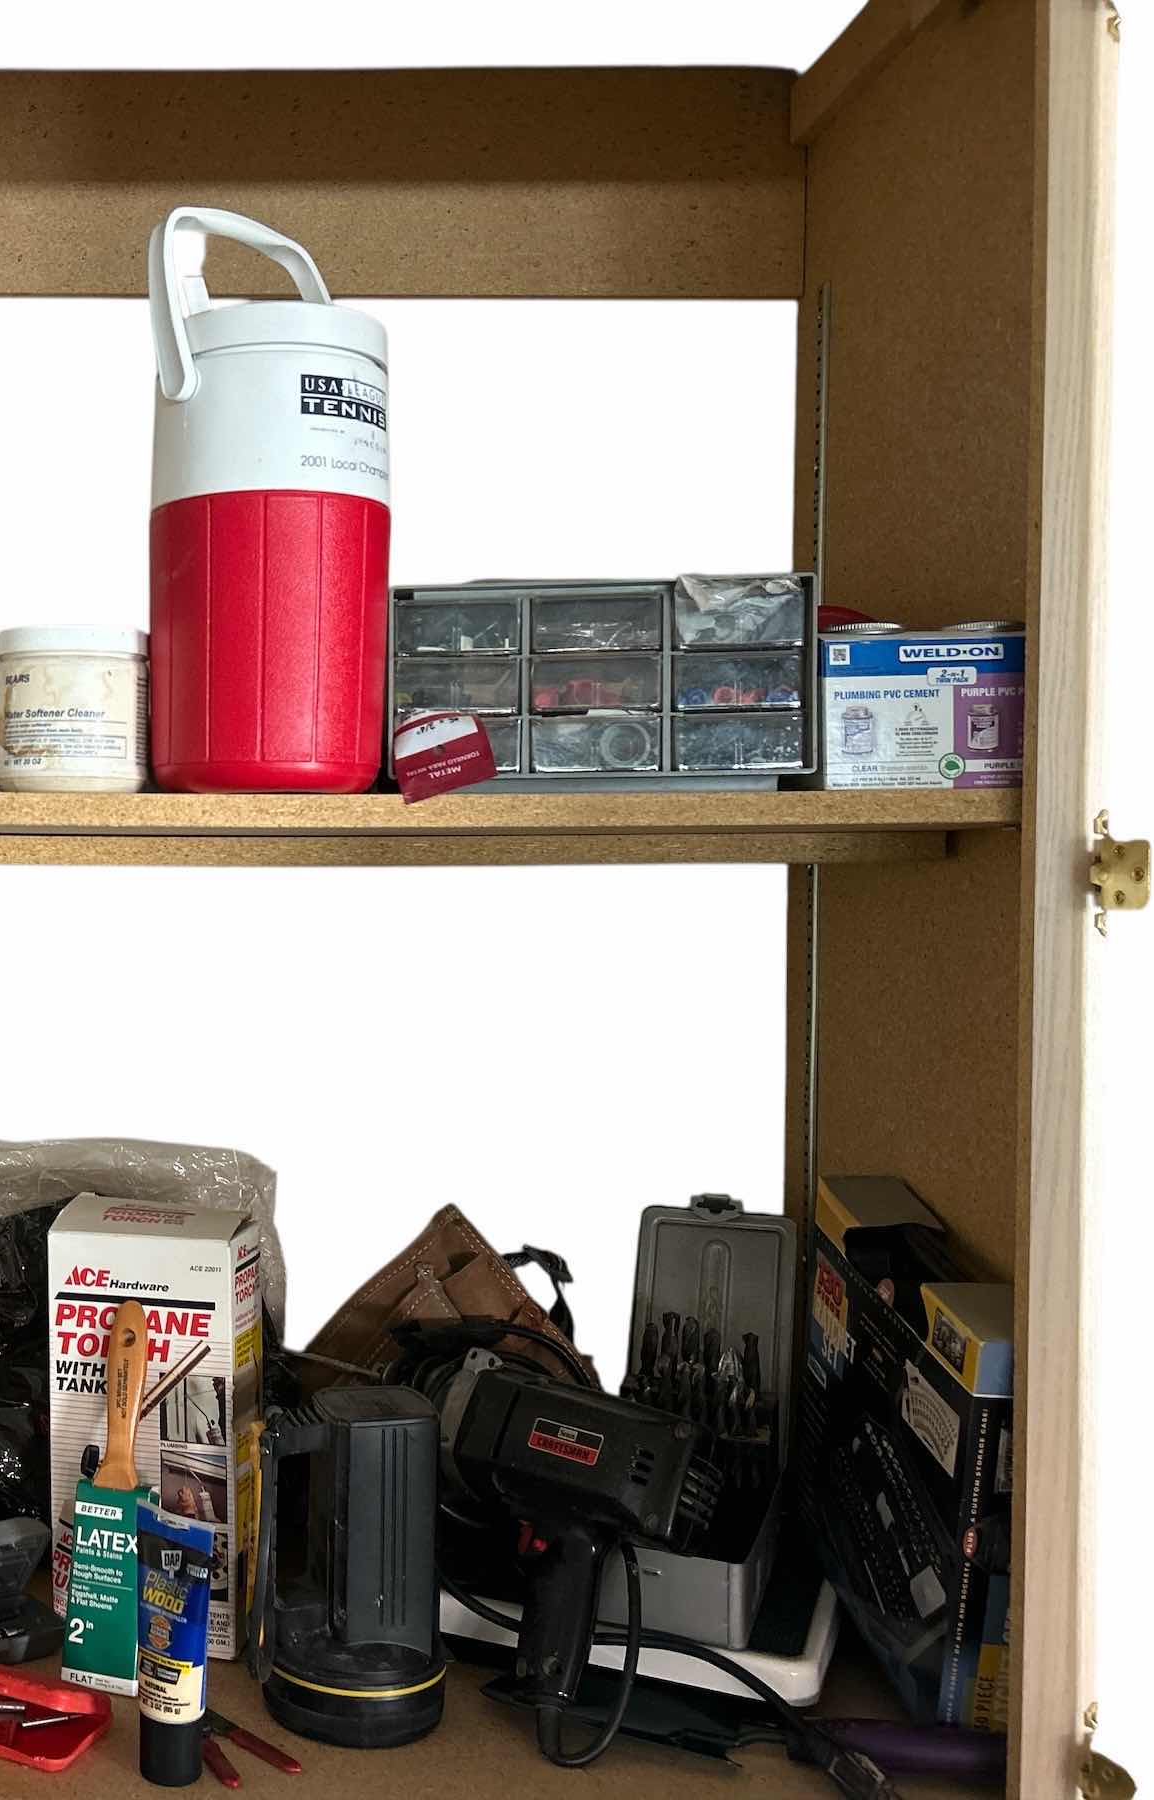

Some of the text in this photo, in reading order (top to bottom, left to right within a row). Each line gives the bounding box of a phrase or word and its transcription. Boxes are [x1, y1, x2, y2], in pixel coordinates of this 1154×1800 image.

[305, 378, 338, 393] USA
[301, 455, 327, 468] 2001
[834, 688, 940, 700] PLUMBING PVC CEMENT
[961, 687, 996, 697] PURPLE
[26, 709, 65, 718] Softener
[67, 708, 105, 718] Cleaner
[429, 765, 461, 779] METAL
[852, 764, 878, 772] CLEAR
[65, 1265, 169, 1292] ACE Hardware
[55, 1303, 212, 1337] PROANE
[57, 1332, 170, 1362] TOH
[56, 1360, 106, 1378] WITH
[57, 1377, 108, 1396] TANK
[975, 1438, 985, 1477] STORAGE
[971, 1480, 980, 1515] CUSTOM
[81, 1503, 117, 1517] BETTER
[77, 1526, 138, 1554] LATEX
[73, 1568, 122, 1584] Rough Surfaces
[143, 1586, 185, 1615] WOOD
[70, 1672, 94, 1685] FLAT
